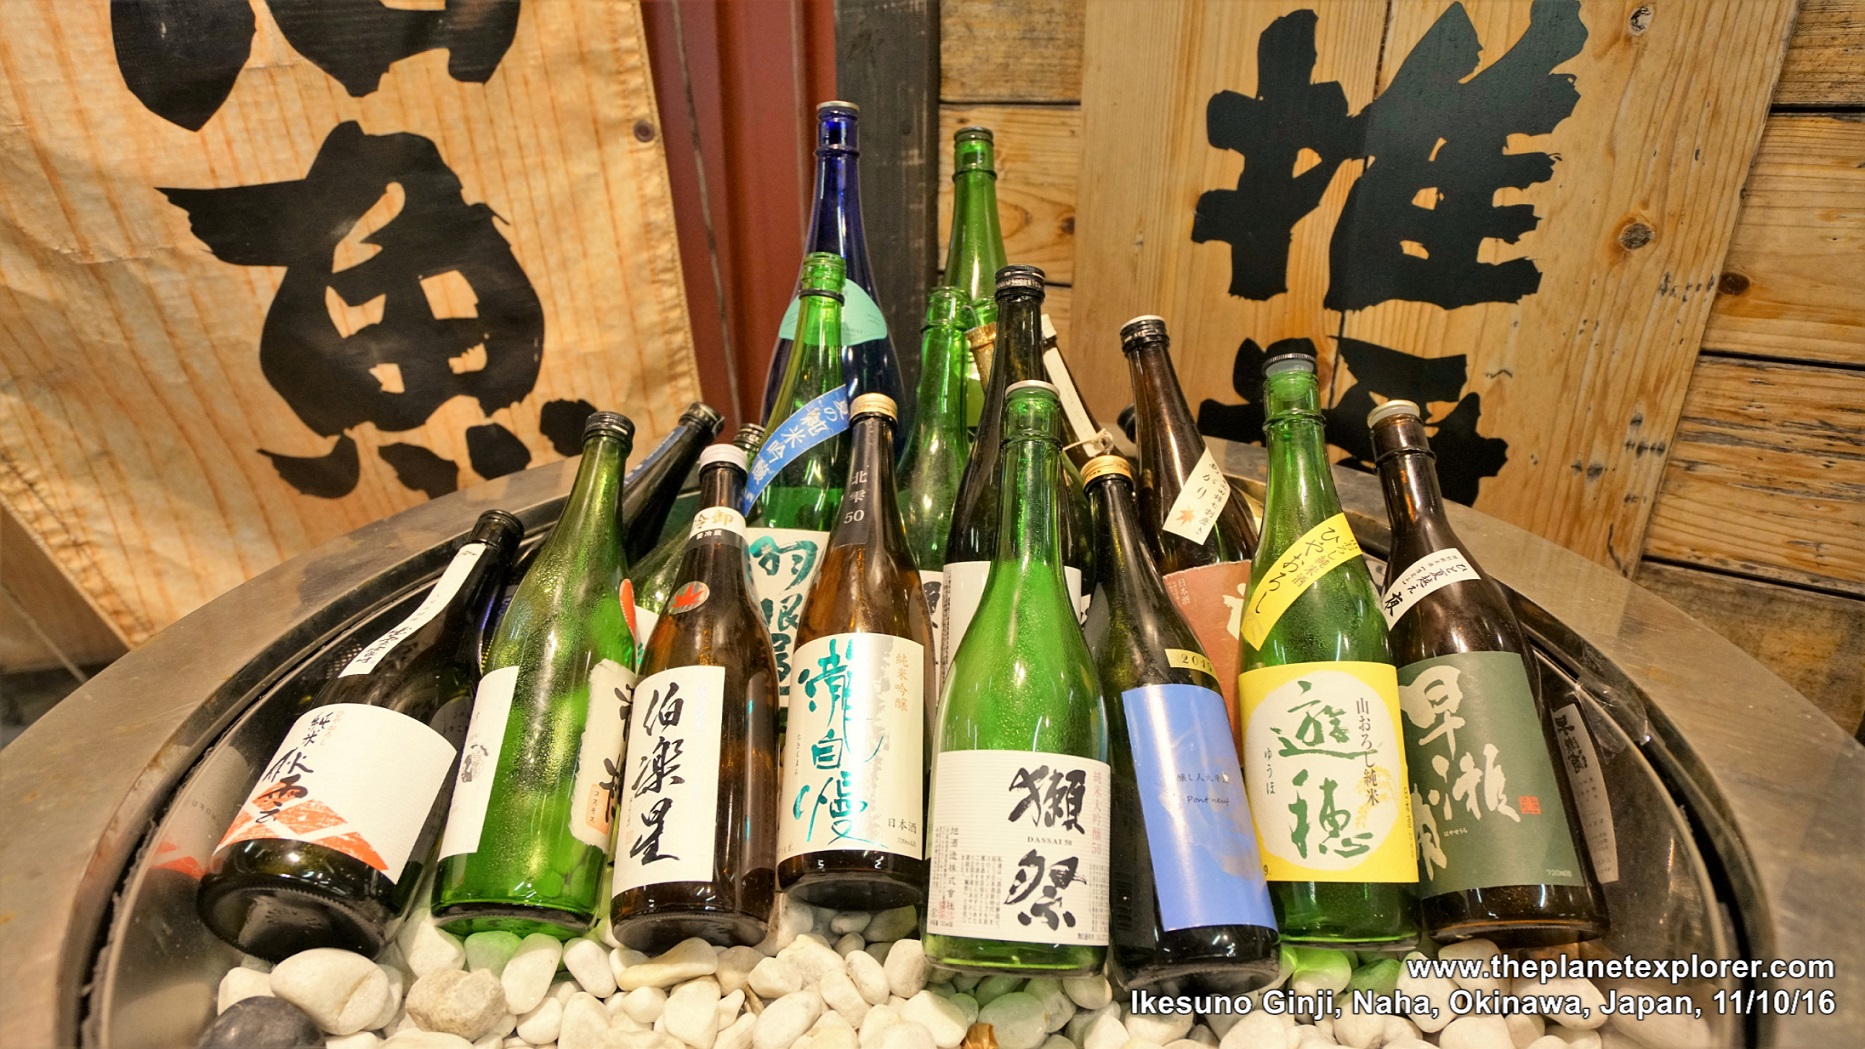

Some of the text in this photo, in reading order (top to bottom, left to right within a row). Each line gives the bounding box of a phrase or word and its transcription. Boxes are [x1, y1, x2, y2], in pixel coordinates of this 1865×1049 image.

[1255, 526, 1340, 614] ひやおろし
[894, 653, 910, 712] 純米吟醸
[1264, 747, 1276, 796] ゆうほ
[1355, 697, 1380, 807] 山おろし純米
[888, 817, 917, 834] 日本酒
[1187, 795, 1209, 804] Pont
[1004, 764, 1088, 931] 獺祭
[1027, 836, 1062, 845] DASSAI
